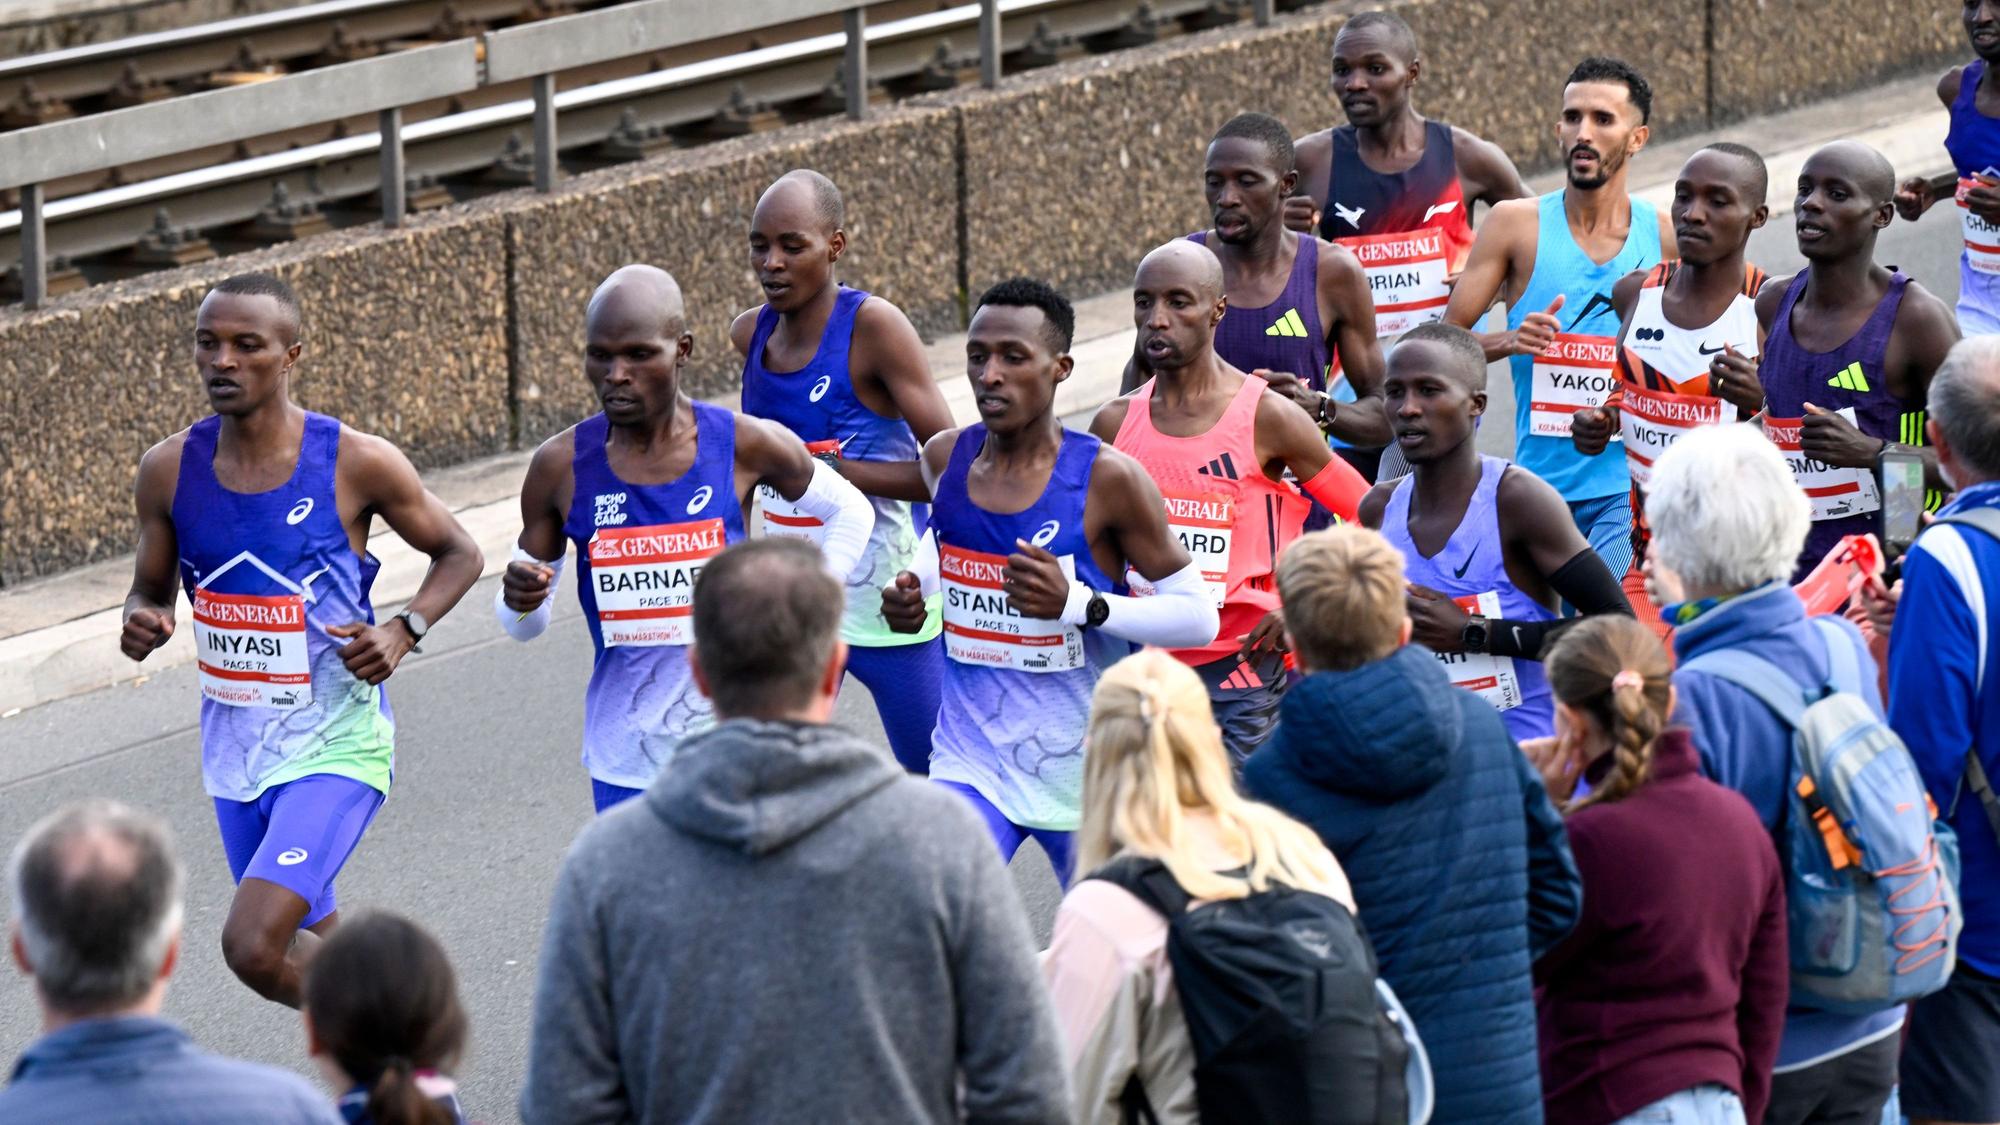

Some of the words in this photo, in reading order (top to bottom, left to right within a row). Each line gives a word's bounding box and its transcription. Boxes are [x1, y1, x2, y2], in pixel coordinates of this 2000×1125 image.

[1359, 236, 1440, 262] GENERALI
[1563, 342, 1617, 362] GENE
[1637, 395, 1716, 423] GENERALI
[595, 513, 627, 526] CAMP
[1163, 498, 1230, 521] NERALI
[621, 531, 720, 558] GENERALI
[1178, 532, 1226, 554] ARD
[962, 560, 1006, 583] GEN
[640, 596, 672, 607] PACE
[676, 595, 689, 605] 70
[948, 587, 1019, 617] STANL
[209, 602, 299, 625] GENERALI
[975, 619, 1004, 631] PACE
[1007, 623, 1020, 634] 73
[208, 632, 281, 657] INYASI
[223, 659, 253, 671] PACE
[256, 661, 268, 672] 72
[1023, 659, 1048, 668] PUMA
[272, 697, 295, 705] PUMA
[1502, 685, 1514, 708] PACE
